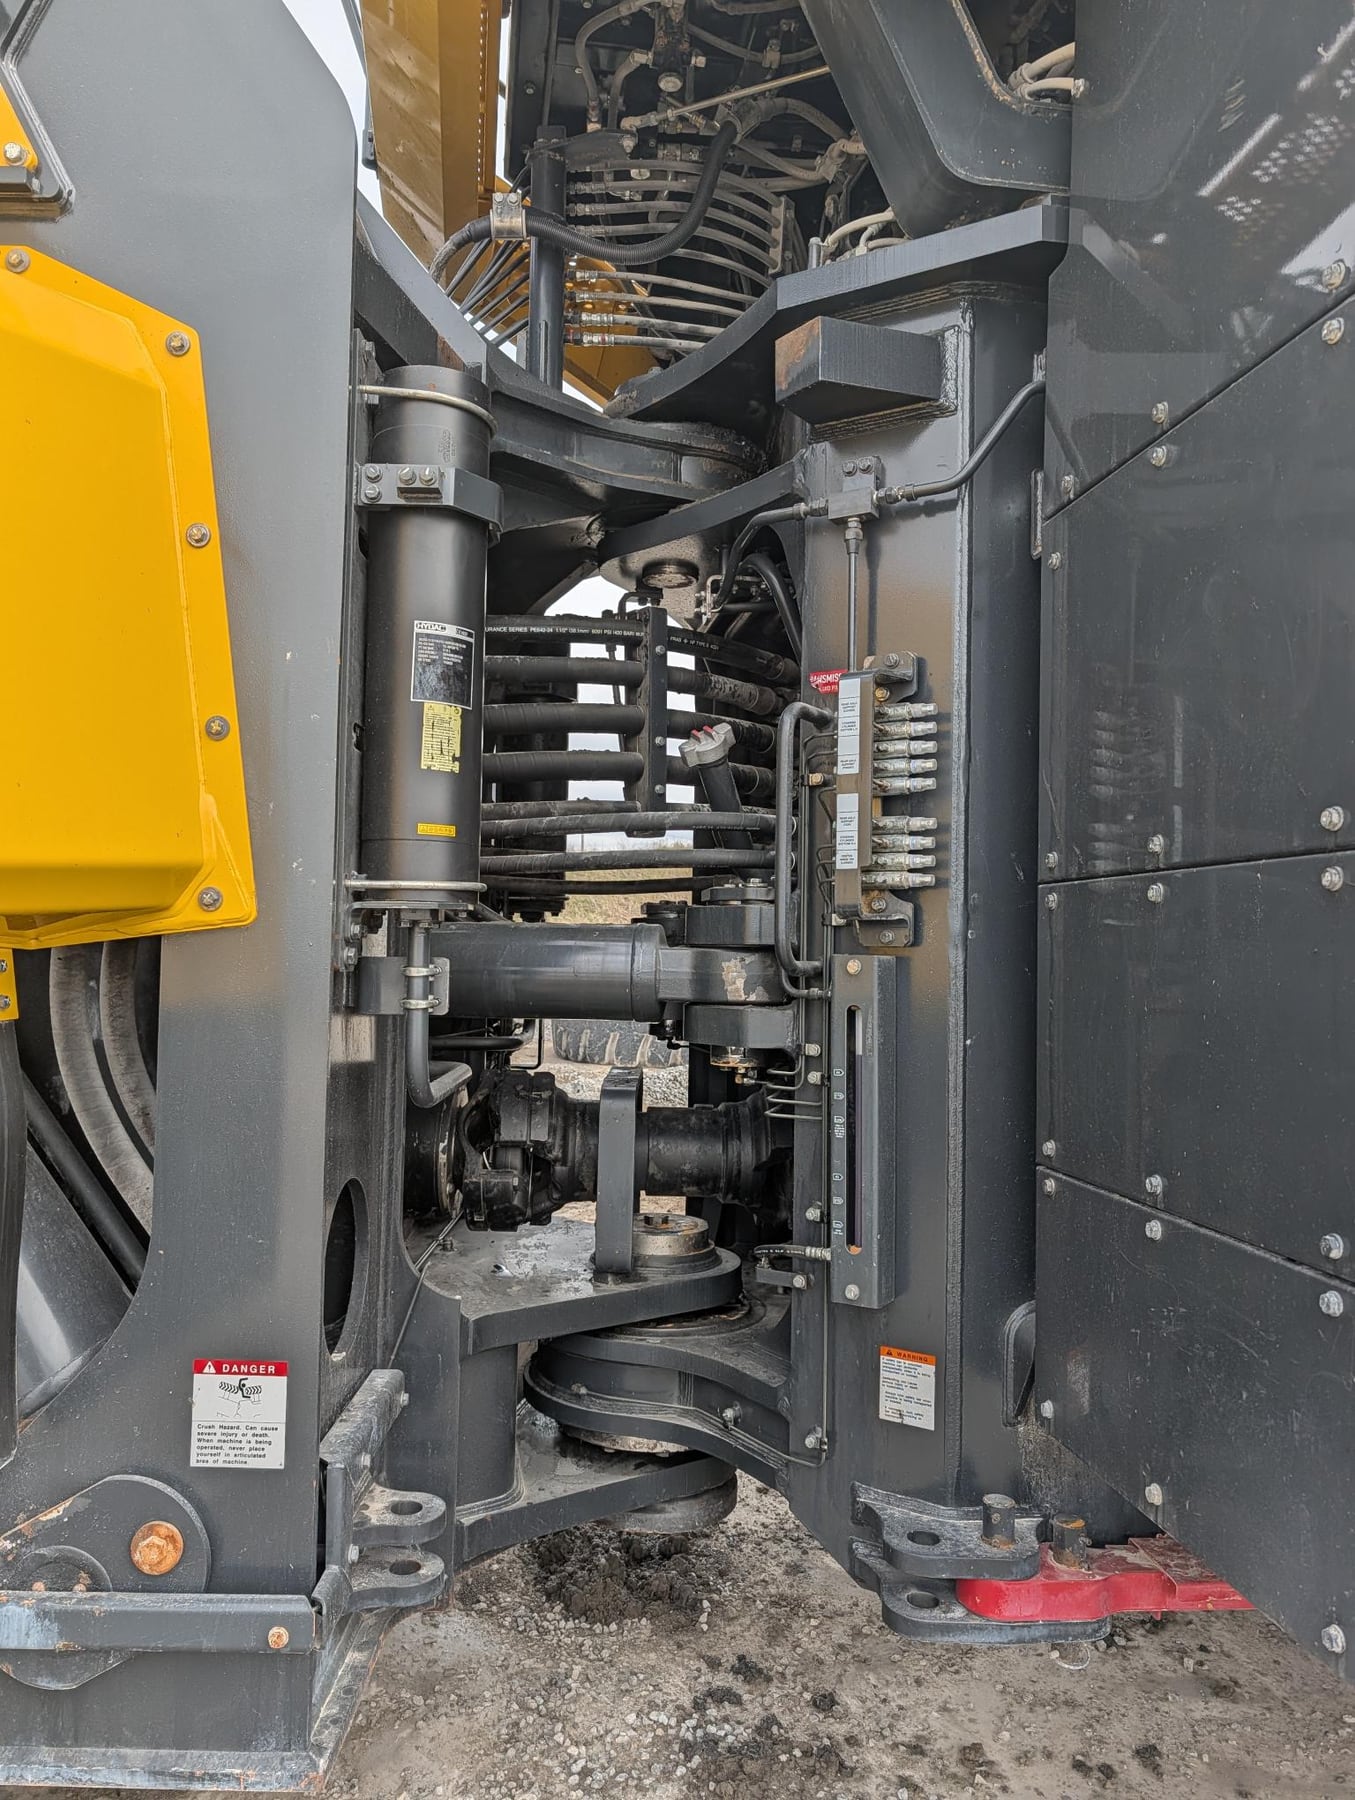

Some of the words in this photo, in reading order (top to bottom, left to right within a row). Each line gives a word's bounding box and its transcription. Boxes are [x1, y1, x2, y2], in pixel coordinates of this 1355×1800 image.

[896, 1351, 928, 1362] WARNING
[222, 1364, 276, 1374] DANGER
[255, 1438, 272, 1446] being
